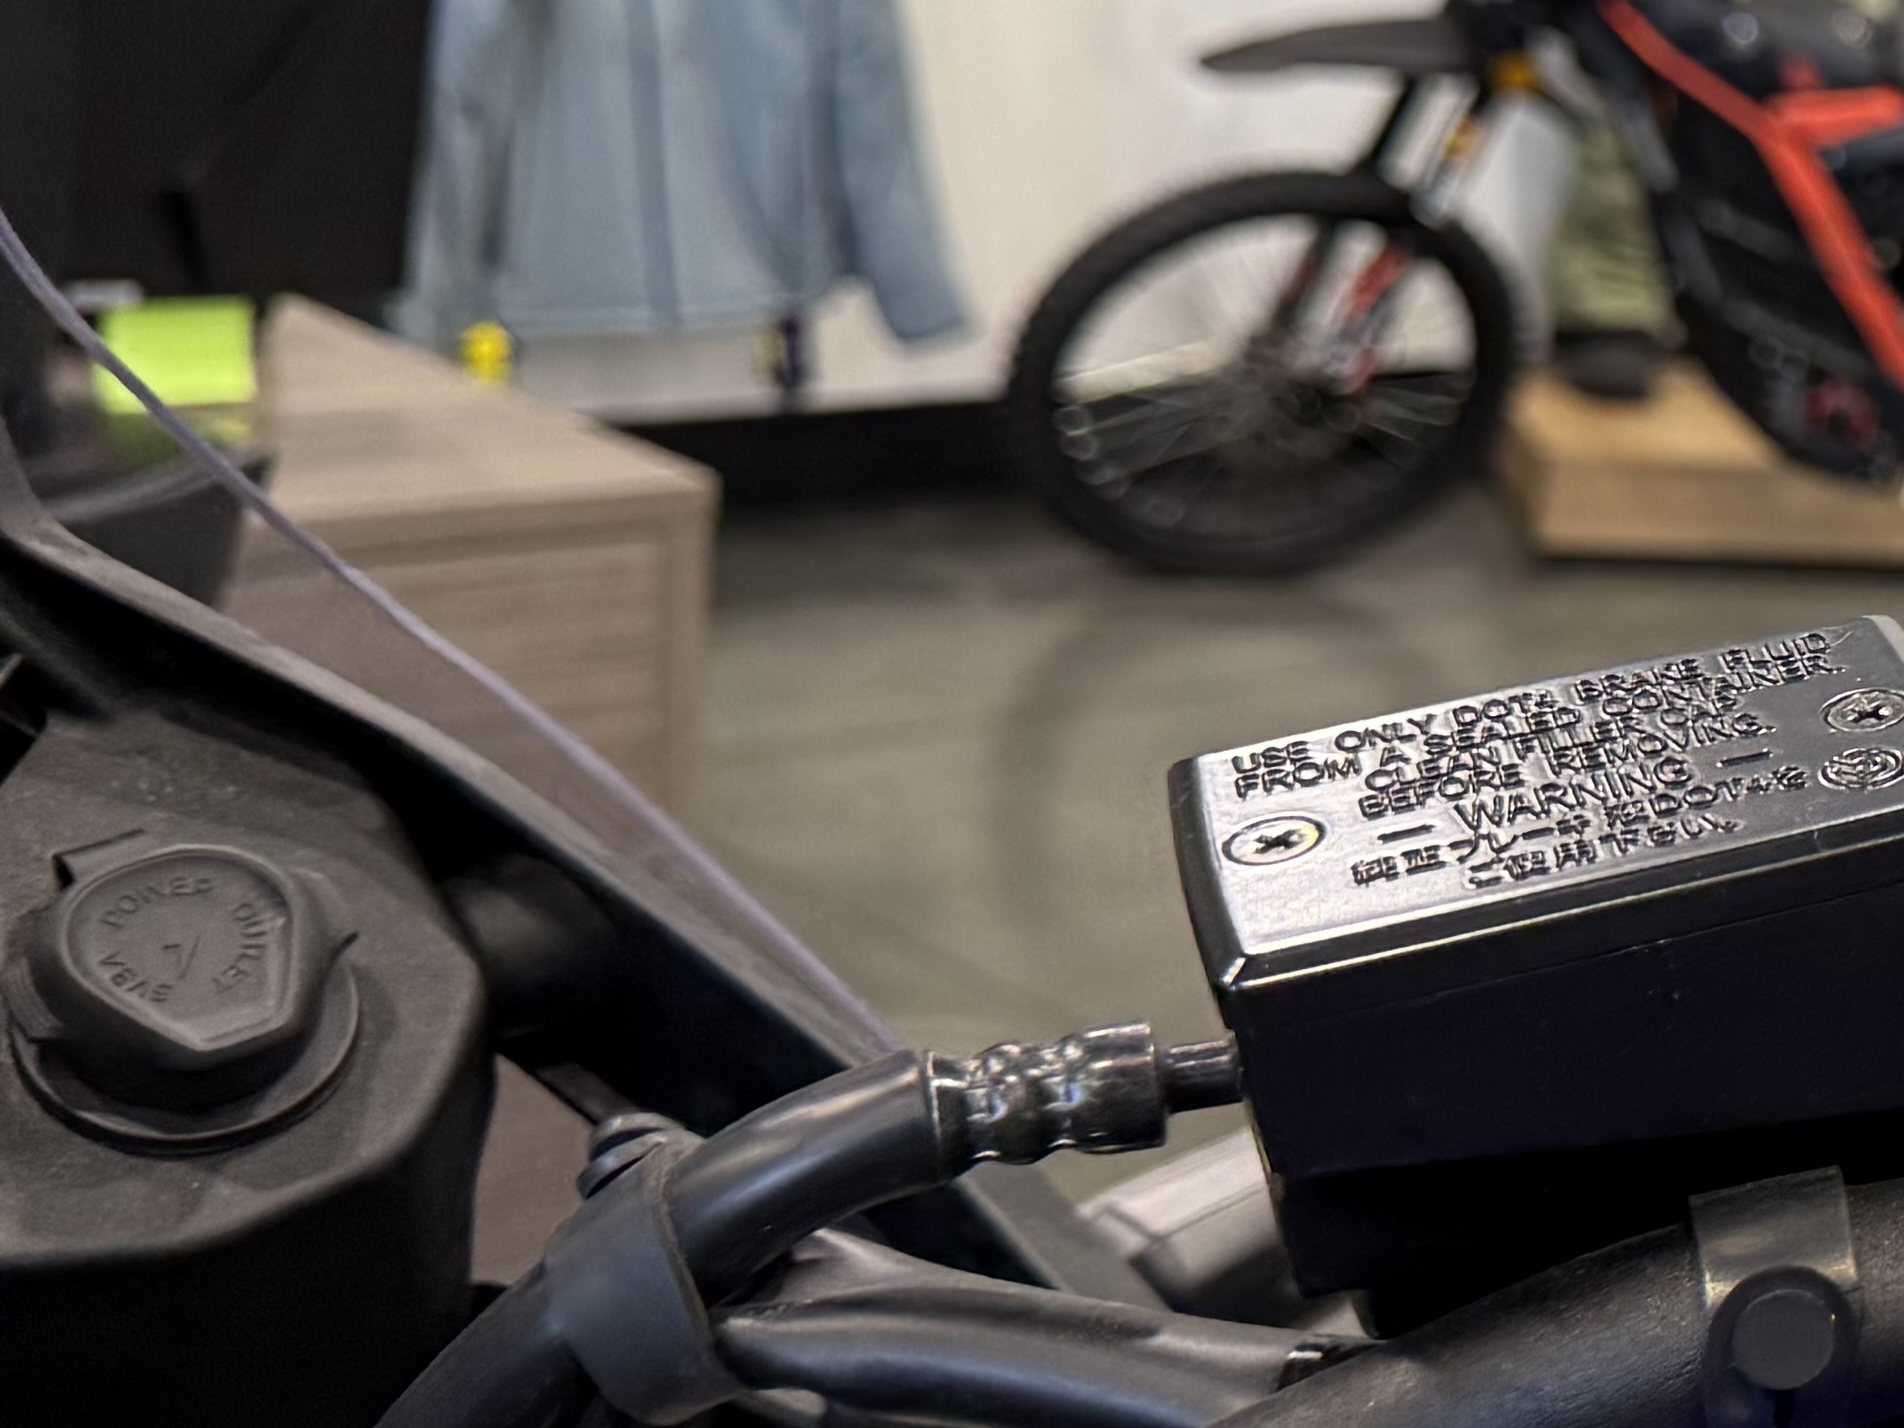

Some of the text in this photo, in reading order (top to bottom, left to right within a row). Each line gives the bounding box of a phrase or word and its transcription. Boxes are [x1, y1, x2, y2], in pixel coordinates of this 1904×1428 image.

[1231, 741, 1310, 774] USE
[1334, 714, 1440, 752] ONLY
[1574, 658, 1702, 702] BRAKE
[1717, 631, 1834, 672] FLUID
[1234, 649, 1846, 798] FROM A SEALED CONTAINER.
[1364, 694, 1741, 792] CLEAN FILLER CAP
[1358, 765, 1525, 819] BEFORE
[1547, 711, 1777, 777] REMOVING.
[1453, 756, 1694, 833] WARNING
[100, 876, 216, 928] POWER
[211, 902, 267, 994] OUTLET
